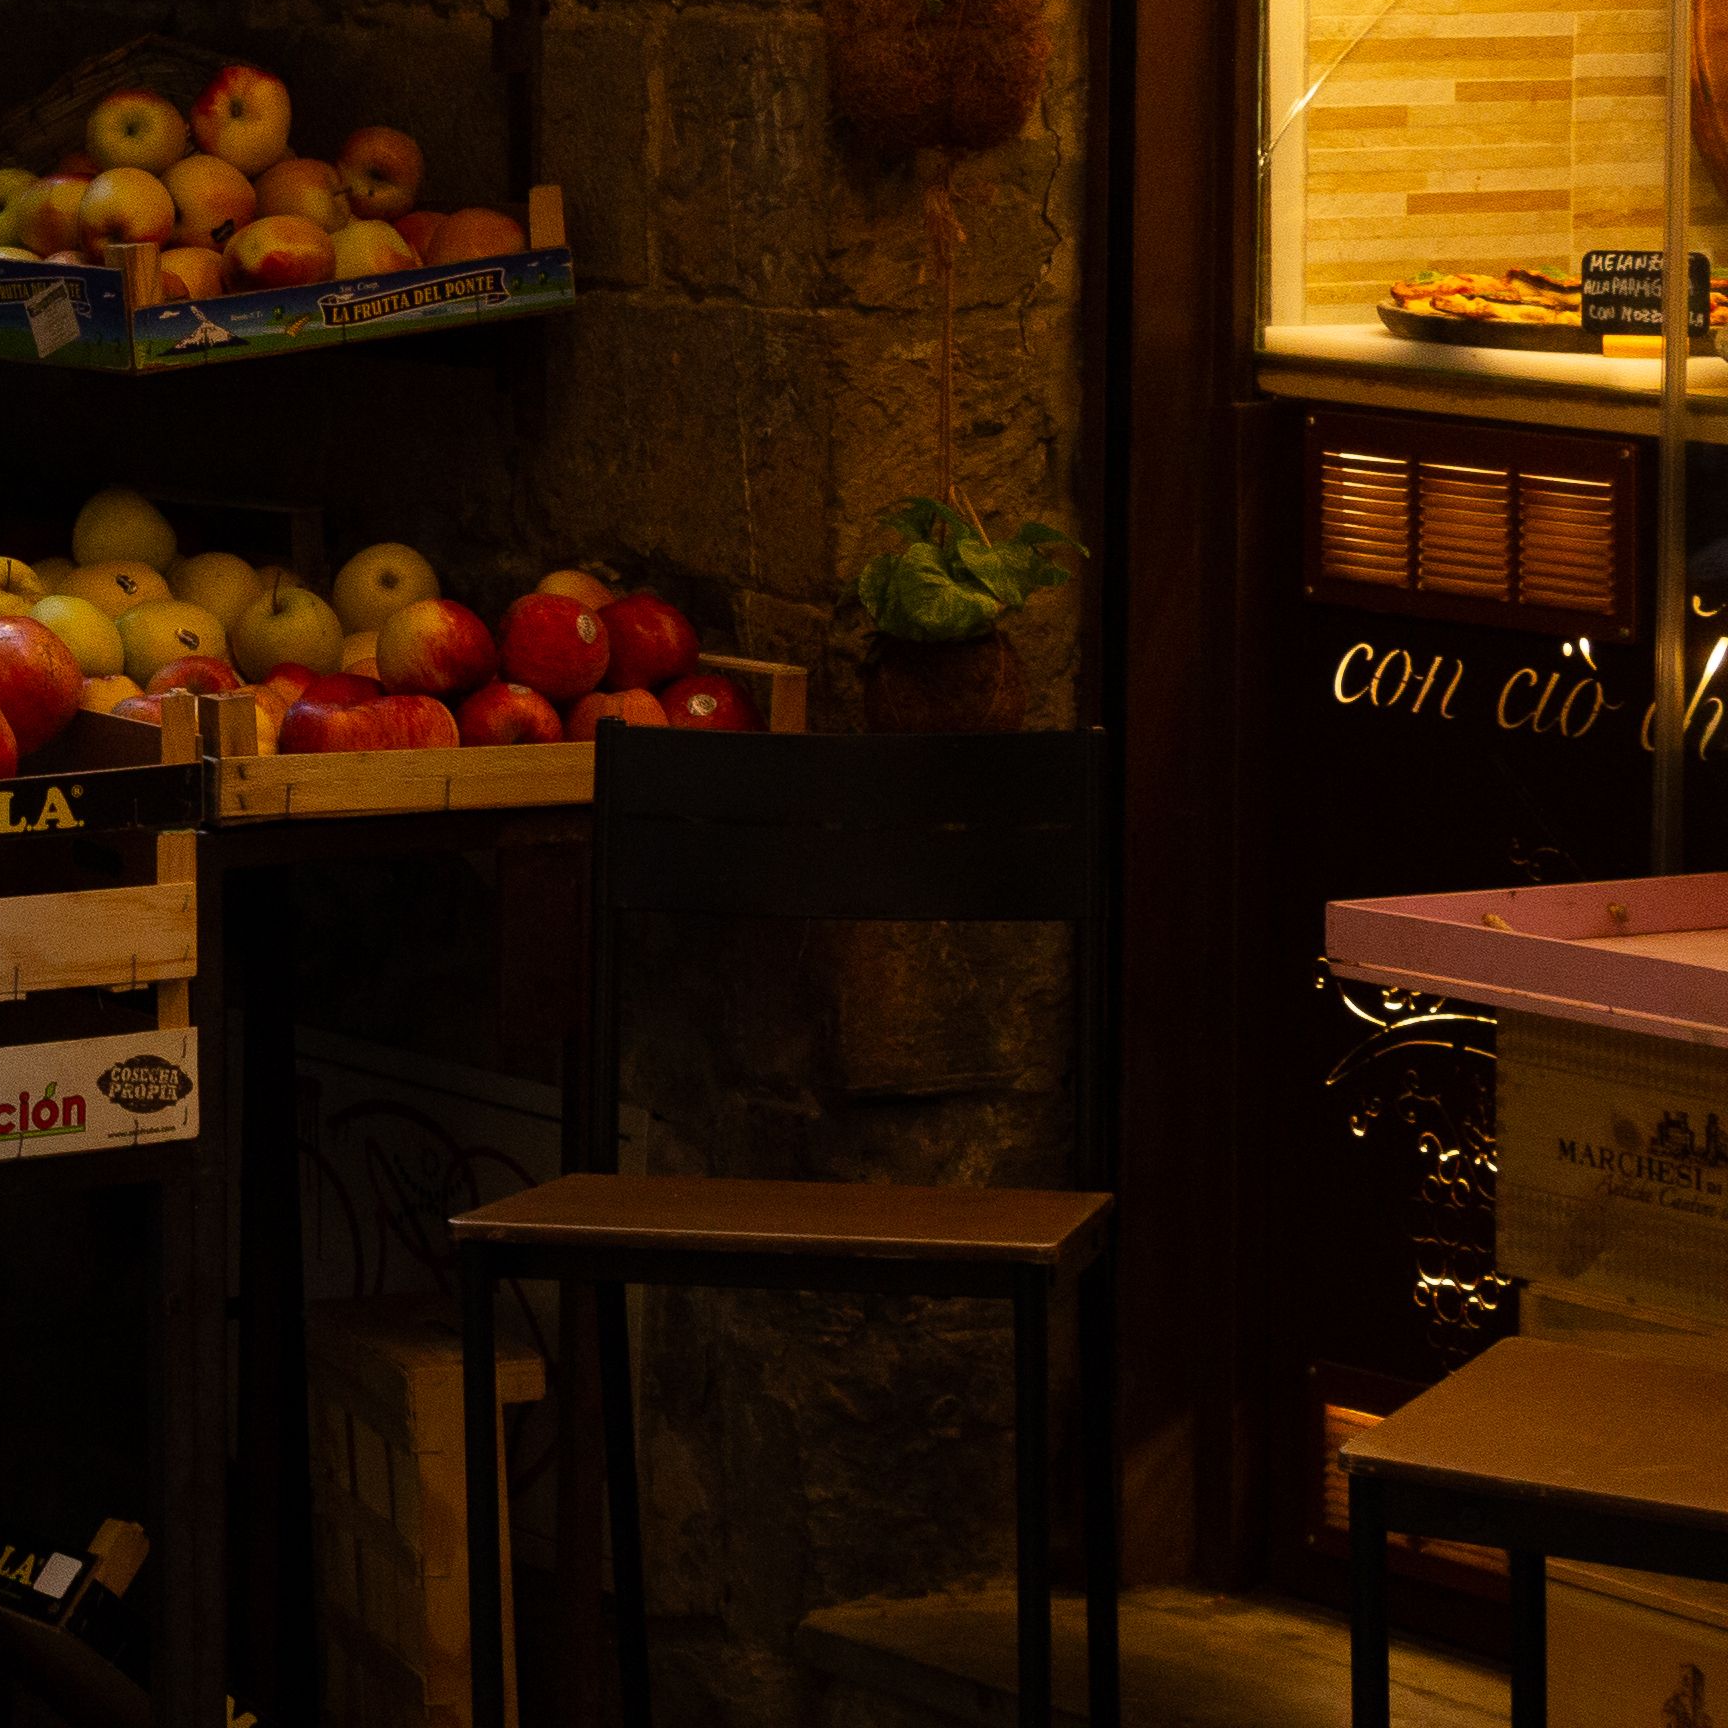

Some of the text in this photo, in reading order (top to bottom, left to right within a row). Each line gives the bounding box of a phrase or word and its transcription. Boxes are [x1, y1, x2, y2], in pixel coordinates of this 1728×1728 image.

[331, 272, 495, 325] LA FRUTTA DEL PONTE
[1333, 641, 1464, 720] con
[1495, 636, 1625, 739] ciò
[108, 1064, 181, 1086] COSECHA
[108, 1081, 179, 1102] PROPIA
[1557, 1136, 1702, 1191] MARCHESI
